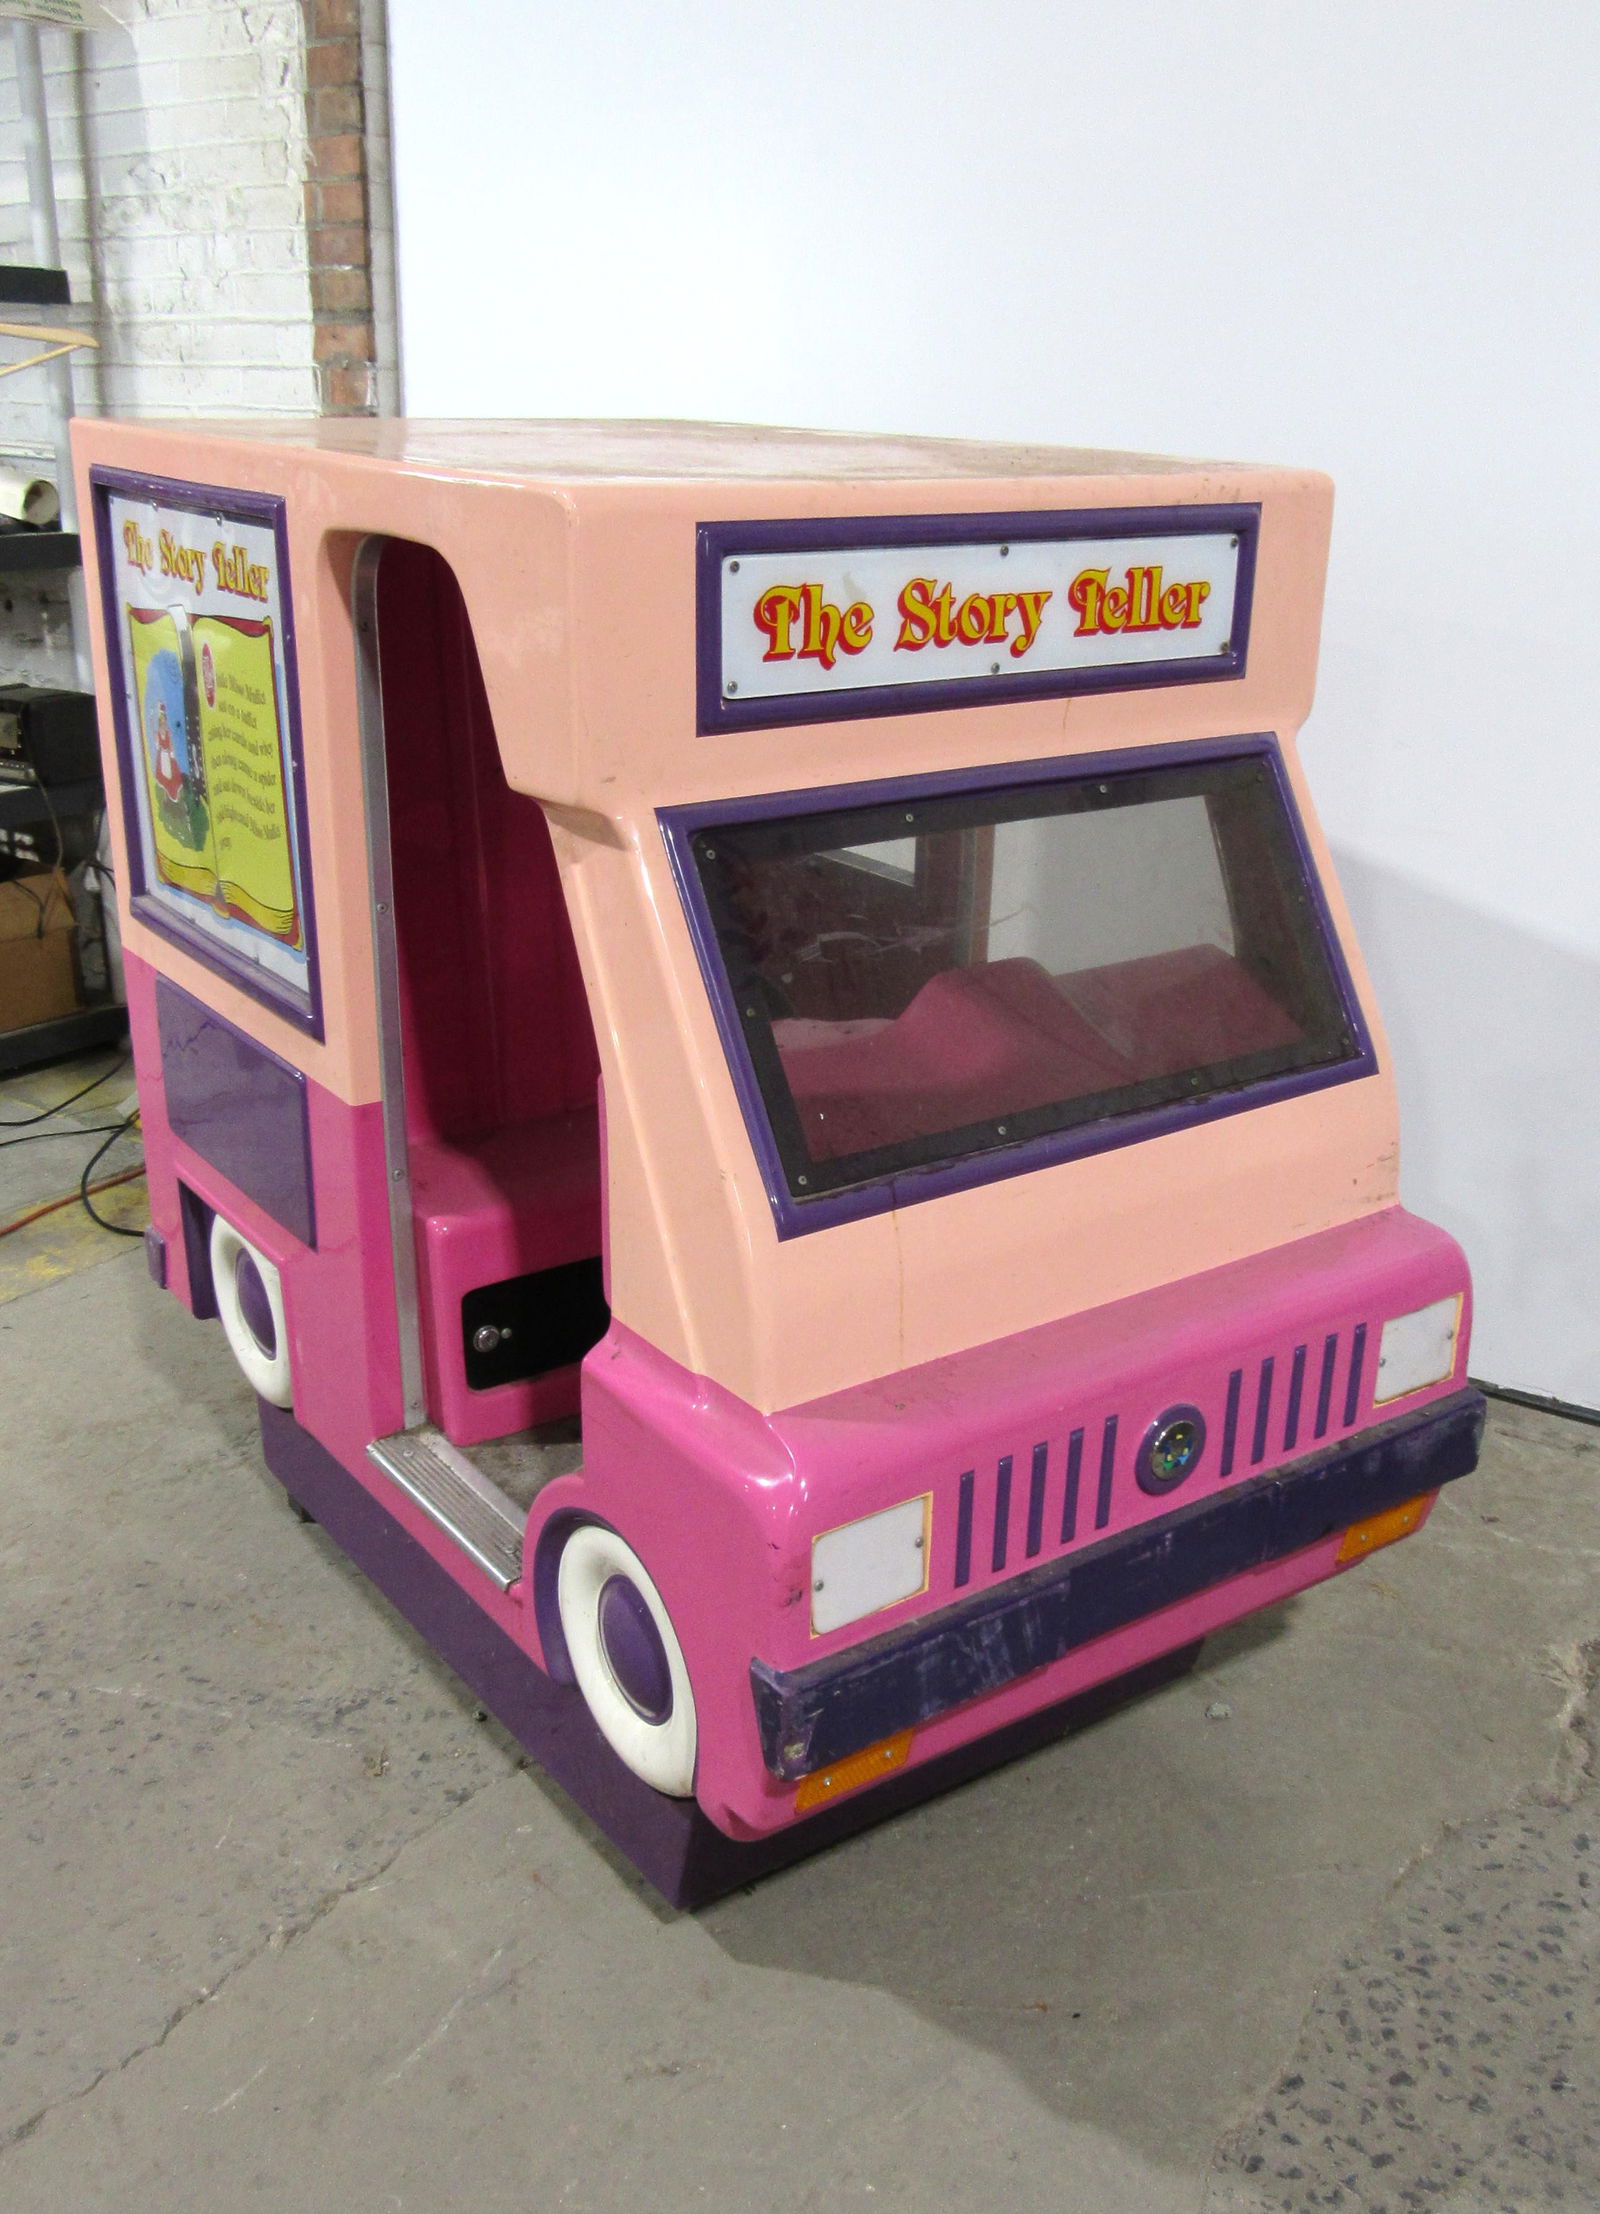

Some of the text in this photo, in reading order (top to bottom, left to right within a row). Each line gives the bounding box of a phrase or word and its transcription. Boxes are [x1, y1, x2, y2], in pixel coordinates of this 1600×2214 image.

[123, 520, 270, 603] The Story Teller
[753, 566, 1212, 670] The Story Teller
